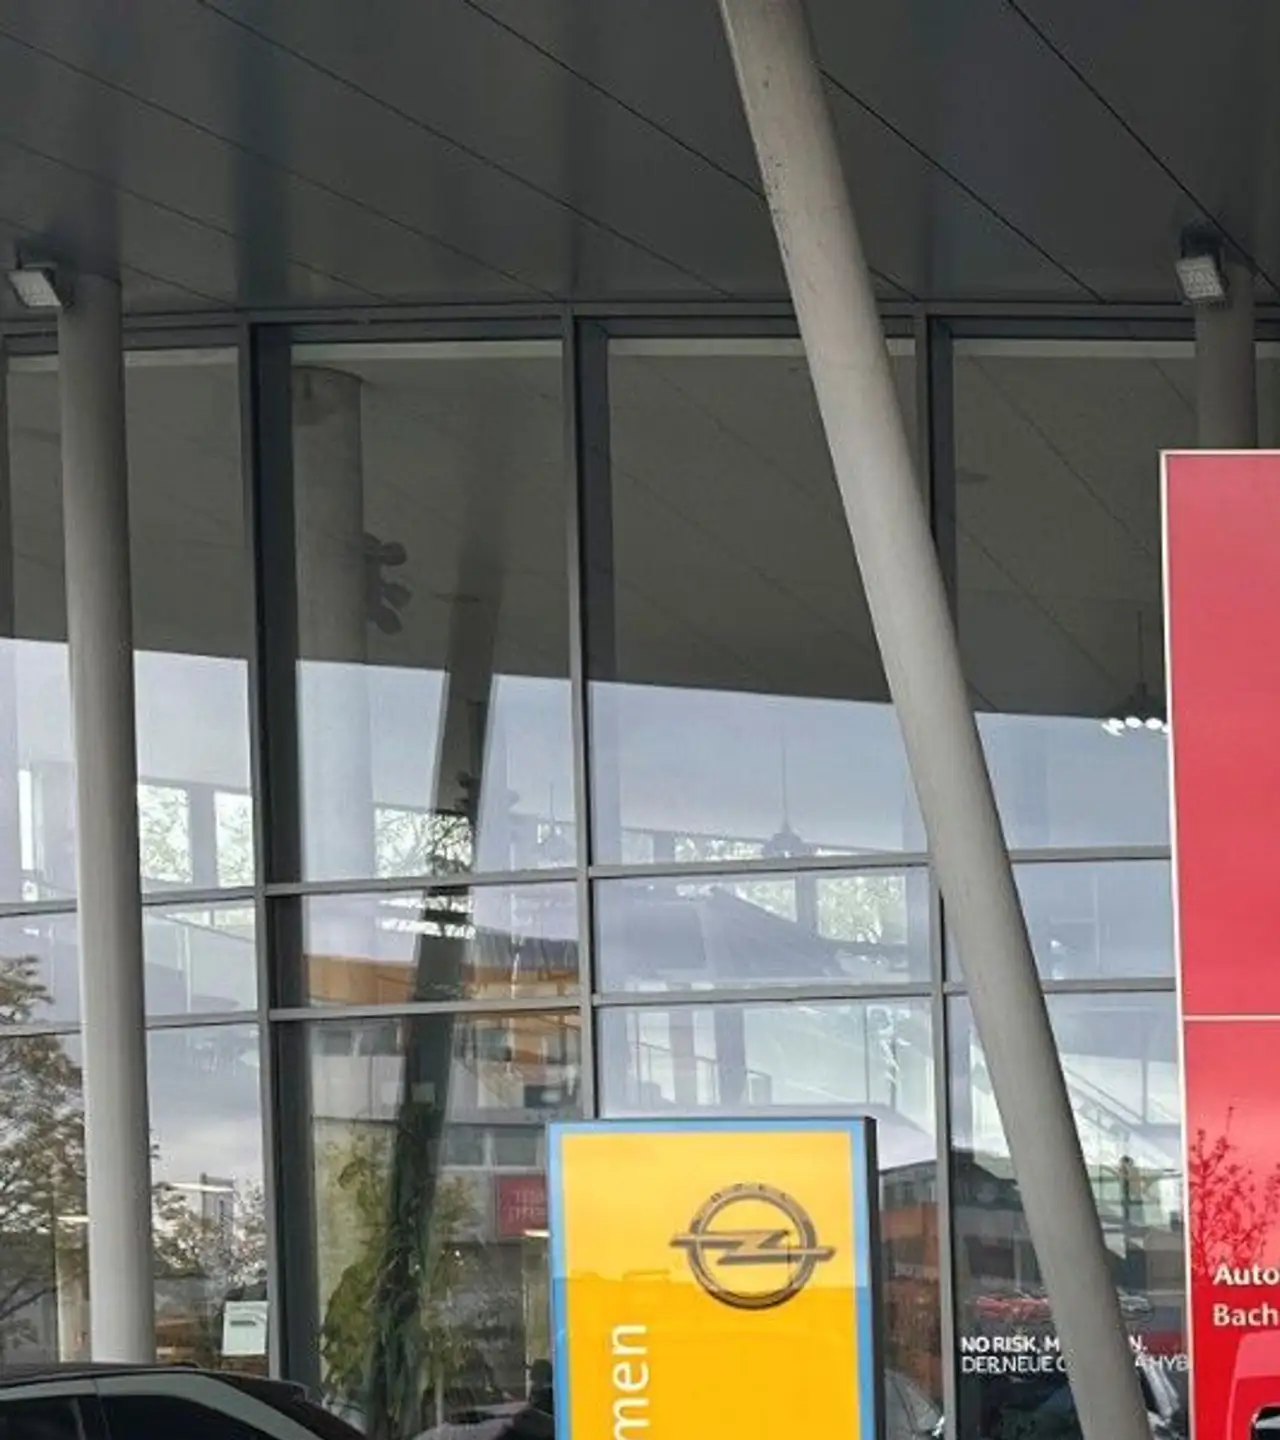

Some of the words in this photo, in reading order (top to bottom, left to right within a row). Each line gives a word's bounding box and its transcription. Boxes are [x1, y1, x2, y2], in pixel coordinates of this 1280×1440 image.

[961, 1336, 990, 1352] NO
[993, 1335, 1041, 1355] RISK,
[961, 1356, 1000, 1373] DER
[1002, 1355, 1053, 1372] NEUE
